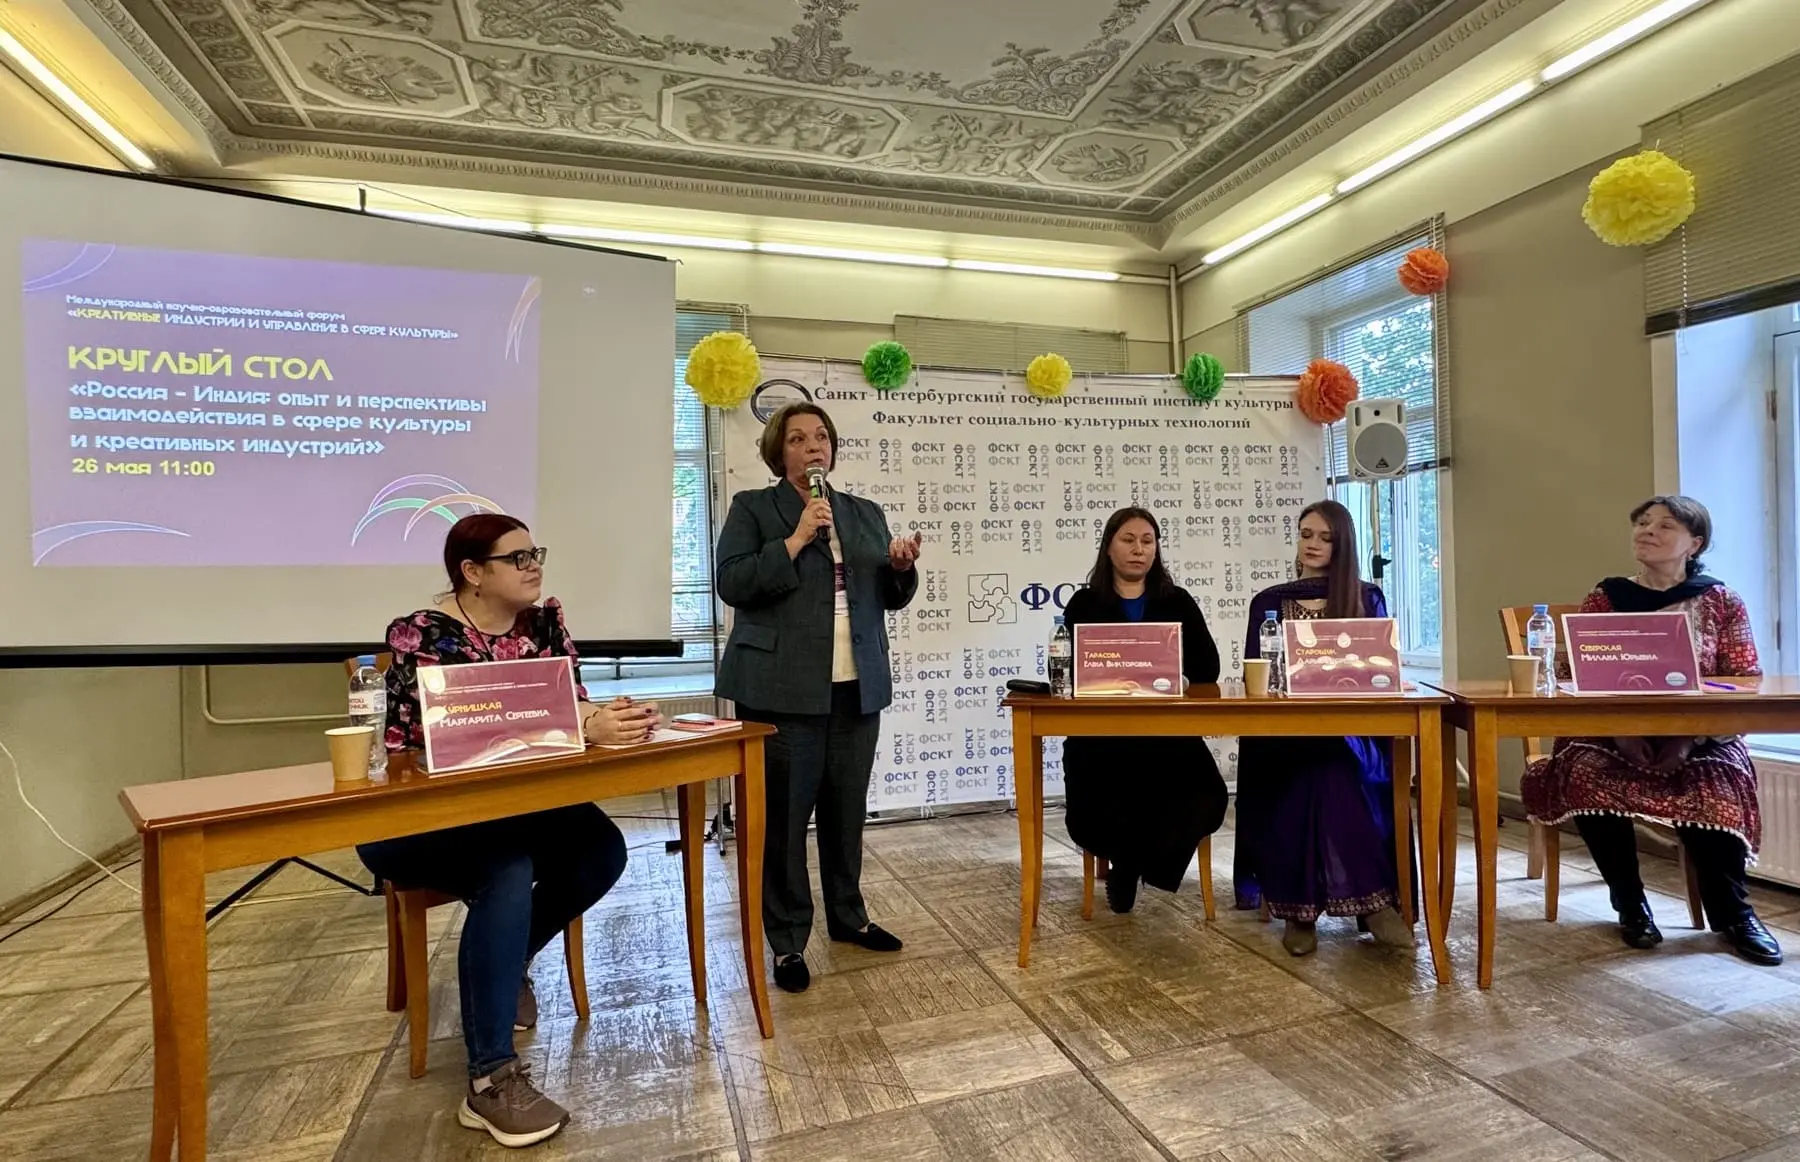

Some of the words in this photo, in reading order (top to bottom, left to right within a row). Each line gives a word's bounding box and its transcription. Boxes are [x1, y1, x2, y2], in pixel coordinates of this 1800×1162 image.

[66, 295, 163, 309] Международный
[166, 303, 303, 317] научно-образовательный
[307, 313, 345, 321] форум
[68, 308, 160, 323] «КРЕАТИВНЫЕ
[165, 314, 245, 328] ИНДУСТРИИ
[248, 319, 259, 329] И
[263, 320, 338, 333] УПРАВЛЕНИЕ
[341, 324, 349, 333] В
[353, 325, 386, 336] СФЕРЕ
[389, 327, 459, 339] КУЛЬТУРЫ»
[68, 346, 232, 376] КРУГЛЫЙ
[244, 356, 334, 381] СТОЛ
[69, 381, 168, 400] «Россия
[194, 386, 270, 404] Индия:
[278, 392, 329, 407] опыт
[337, 395, 351, 407] и
[358, 395, 487, 412] перспективы
[814, 386, 1006, 405] Санкт-Петербургский
[1011, 393, 1147, 407] государственный
[1225, 399, 1294, 411] культуры
[69, 406, 266, 426] взаимодействия
[273, 415, 286, 426] в
[292, 415, 363, 431] сфере
[370, 417, 471, 434] культуры
[872, 411, 964, 427] Факультет
[968, 414, 1159, 430] социально-культурных
[1164, 418, 1251, 429] технологий
[70, 435, 87, 447] и
[96, 435, 236, 452] креативных
[243, 438, 385, 458] индустрий»
[912, 442, 945, 453] ФСКТ
[988, 442, 1020, 453] ФСКТ
[1055, 443, 1086, 453] ФСКТ
[1122, 443, 1152, 453] ФСКТ
[1185, 444, 1213, 454] ФСКТ
[1244, 444, 1272, 454] ФСКТ
[879, 439, 889, 474] ФСКТ
[912, 455, 946, 465] ФСКТ
[953, 444, 963, 478] ФСКТ
[989, 455, 1020, 465] ФСКТ
[1028, 444, 1037, 478] ФСКТ
[1056, 456, 1086, 466] ФСКТ
[1094, 445, 1103, 478] ФСКТ
[1123, 456, 1152, 466] ФСКТ
[1159, 445, 1168, 477] ФСКТ
[1185, 456, 1214, 466] ФСКТ
[1220, 445, 1229, 476] ФСКТ
[1245, 456, 1273, 466] ФСКТ
[1279, 446, 1288, 476] ФСКТ
[72, 458, 98, 474] 26
[106, 462, 151, 475] мая
[160, 460, 215, 476] 11:00
[870, 484, 904, 495] ФСКТ
[943, 484, 976, 494] ФСКТ
[1013, 483, 1045, 494] ФСКТ
[1086, 483, 1117, 493] ФСКТ
[1153, 482, 1182, 492] ФСКТ
[1214, 482, 1243, 491] ФСКТ
[1275, 481, 1303, 491] ФСКТ
[918, 481, 927, 513] ФСКТ
[990, 480, 999, 512] ФСКТ
[1064, 480, 1072, 511] ФСКТ
[1193, 480, 1201, 509] ФСКТ
[1255, 479, 1263, 508] ФСКТ
[881, 503, 906, 512] СКТ
[944, 501, 977, 512] ФСКТ
[1014, 501, 1045, 511] ФСКТ
[1087, 500, 1118, 510] ФСКТ
[1153, 499, 1183, 509] ФСКТ
[1215, 498, 1243, 508] ФСКТ
[1276, 497, 1304, 507] ФСКТ
[981, 519, 1013, 529] ФСКТ
[1055, 518, 1086, 529] ФСКТ
[1185, 515, 1215, 525] ФСКТ
[1248, 514, 1276, 524] ФСКТ
[909, 520, 942, 531] ФСКТ
[1248, 526, 1276, 536] ФСКТ
[1283, 515, 1292, 546] ФСКТ
[951, 521, 960, 555] ФСКТ
[981, 532, 1013, 542] ФСКТ
[1021, 520, 1030, 554] ФСКТ
[1056, 531, 1087, 541] ФСКТ
[1160, 518, 1169, 549] ФСКТ
[1186, 528, 1215, 537] ФСКТ
[1222, 517, 1231, 548] ФСКТ
[1184, 561, 1214, 571] ФСКТ
[1250, 560, 1280, 569] ФСКТ
[1225, 562, 1233, 592] ФСКТ
[1251, 571, 1280, 580] ФСКТ
[926, 570, 936, 602] ФСКТ
[1185, 577, 1214, 587] ФСКТ
[1217, 599, 1246, 608] ФСКТ
[917, 609, 951, 619] ФСКТ
[1218, 611, 1246, 620] ФСКТ
[917, 622, 951, 632] ФСКТ
[917, 652, 951, 663] ФСКТ
[988, 649, 1021, 659] ФСКТ
[1232, 640, 1240, 670] ФСКТ
[963, 648, 972, 679] ФСКТ
[1036, 644, 1045, 676] ФСКТ
[892, 651, 901, 684] ФСКТ
[989, 666, 1021, 677] ФСКТ
[917, 670, 951, 681] ФСКТ
[893, 690, 916, 700] СКТ
[954, 686, 988, 697] ФСКТ
[925, 689, 935, 724] ФСКТ
[955, 699, 988, 709] ФСКТ
[919, 733, 953, 744] ФСКТ
[965, 728, 974, 760] ФСКТ
[894, 733, 903, 765] ФСКТ
[919, 750, 953, 762] ФСКТ
[884, 771, 918, 783] ФСКТ
[955, 766, 988, 777] ФСКТ
[926, 770, 936, 803] ФСКТ
[955, 778, 988, 789] ФСКТ
[997, 765, 1006, 797] ФСКТ
[884, 784, 918, 795] ФСКТ
